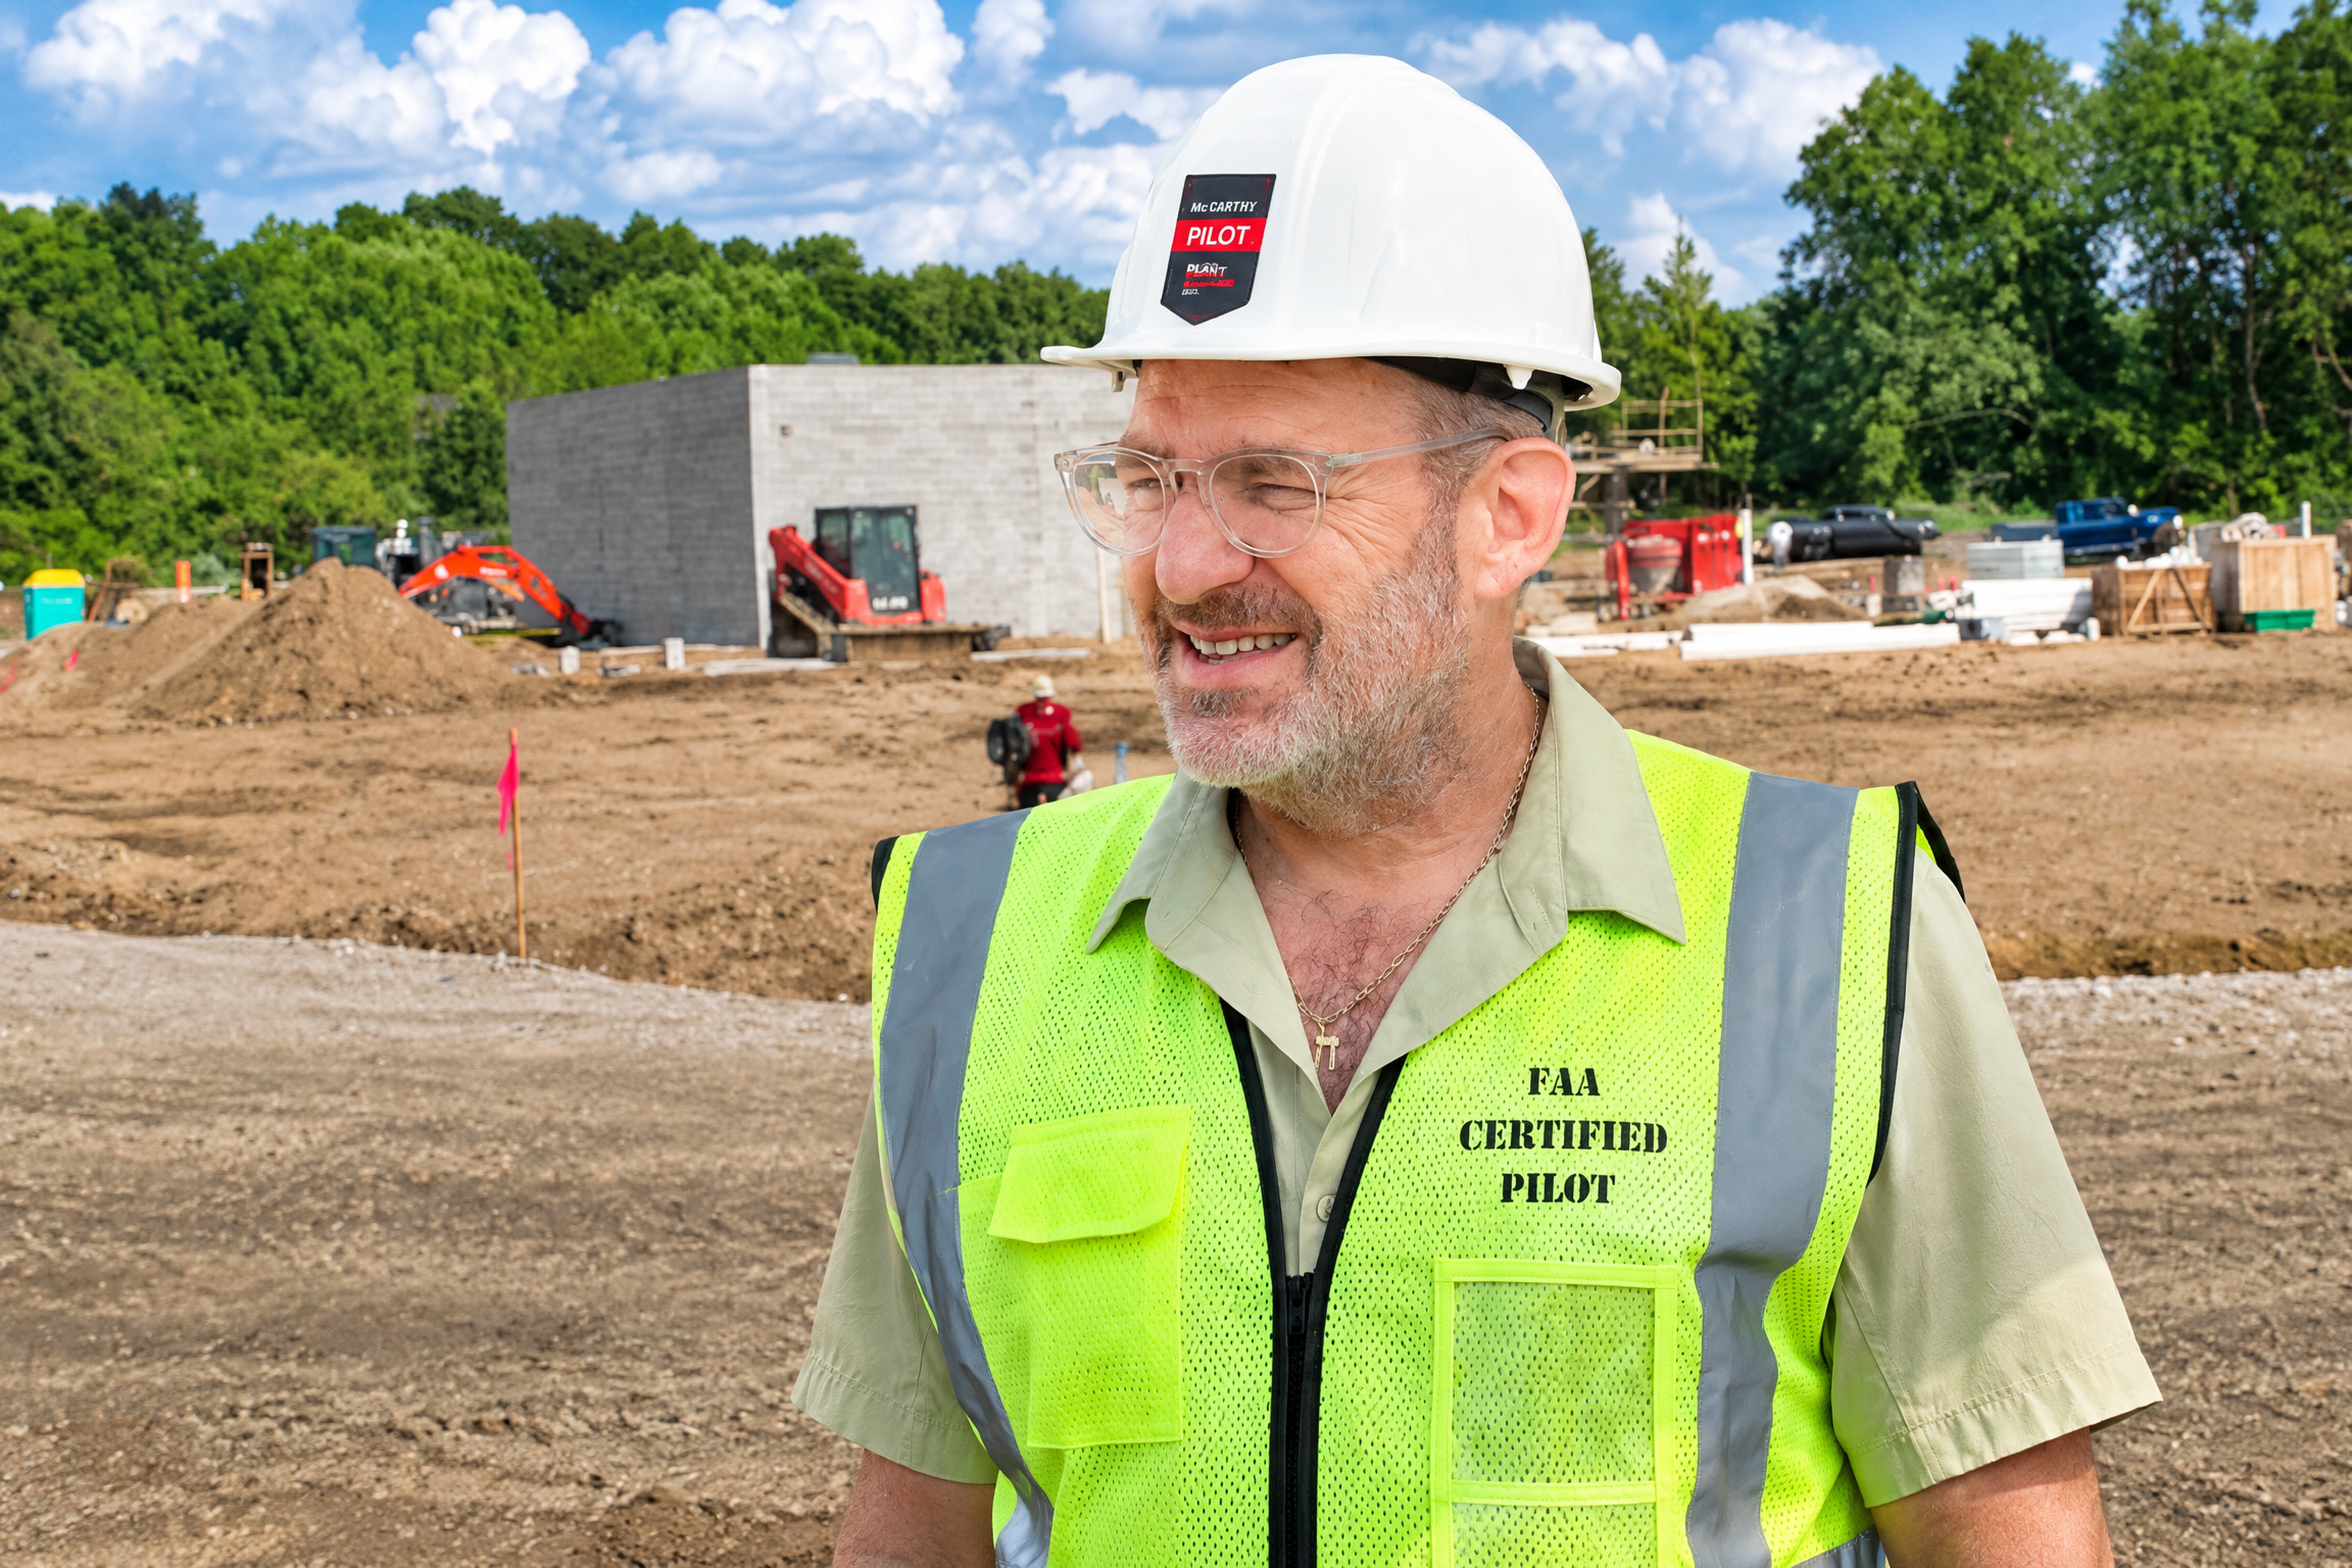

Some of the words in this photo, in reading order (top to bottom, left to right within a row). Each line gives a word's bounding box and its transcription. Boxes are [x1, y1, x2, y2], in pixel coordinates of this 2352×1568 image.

[1186, 226, 1251, 245] PILOT
[1528, 1068, 1600, 1096] FAA
[1460, 1120, 1667, 1153] CERTIFIED
[1501, 1173, 1615, 1203] PILOT
